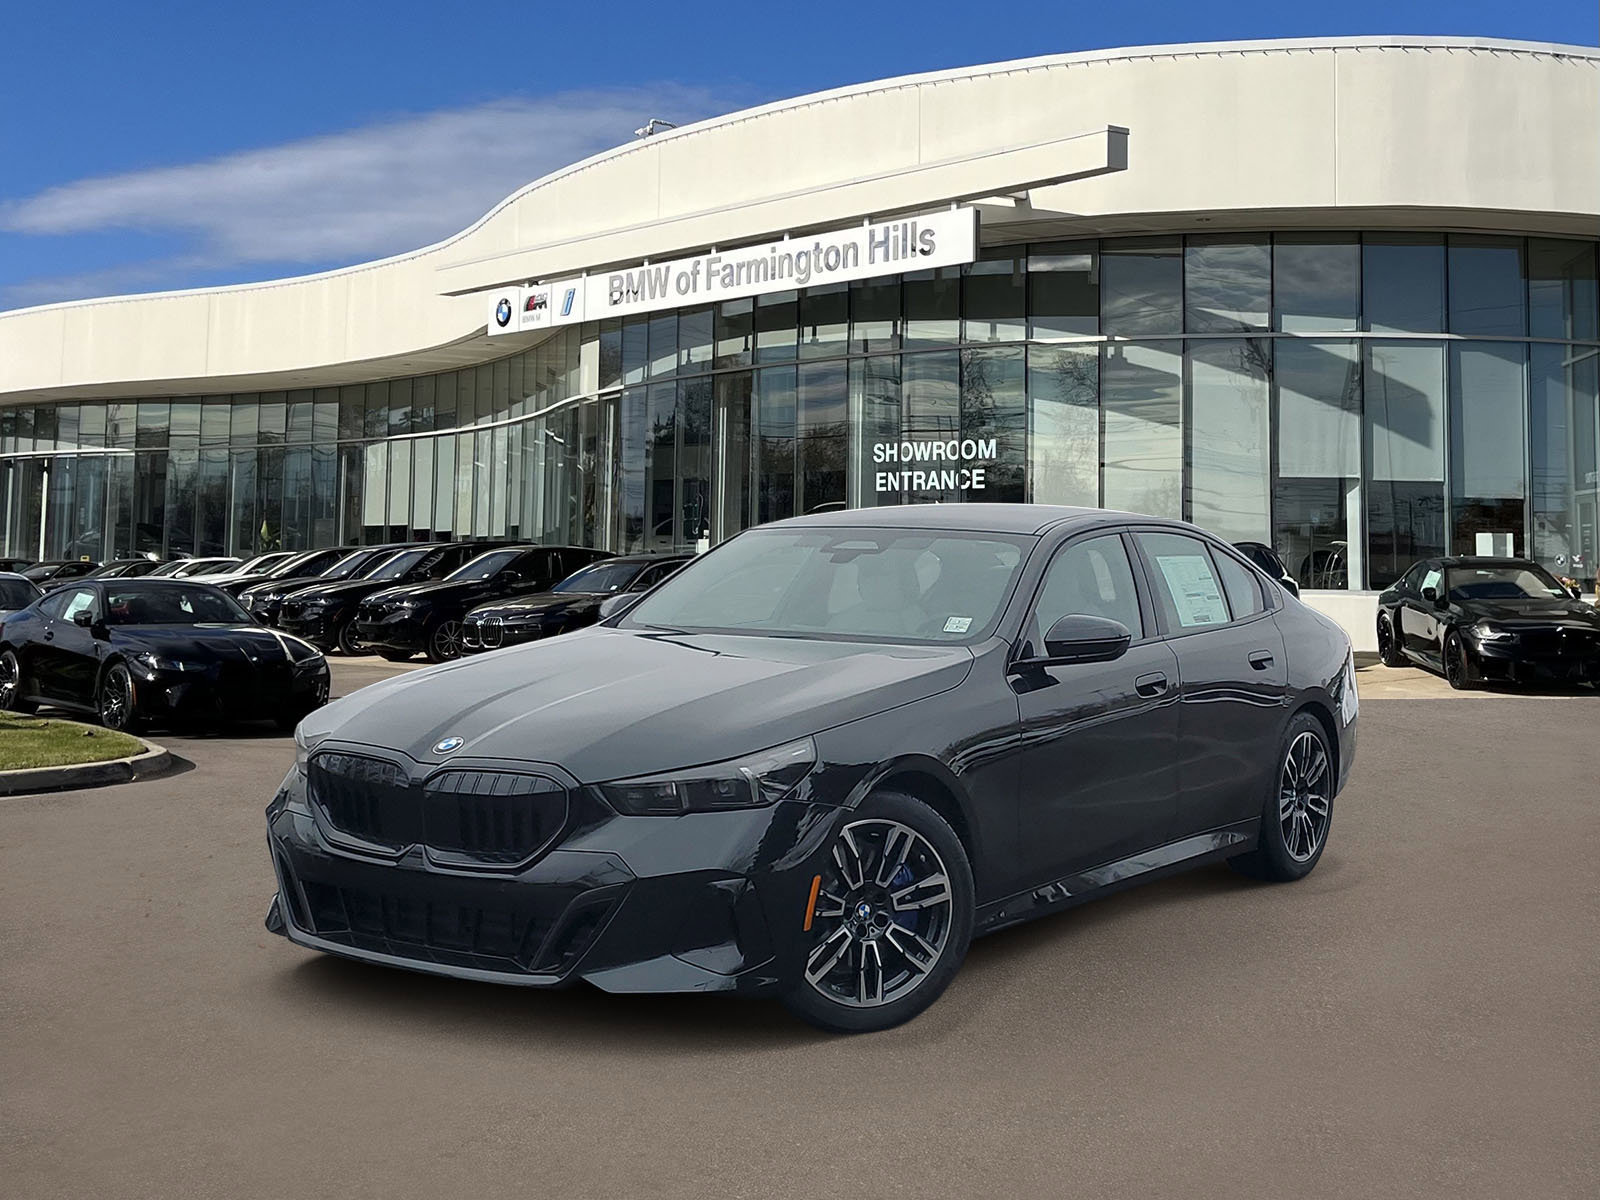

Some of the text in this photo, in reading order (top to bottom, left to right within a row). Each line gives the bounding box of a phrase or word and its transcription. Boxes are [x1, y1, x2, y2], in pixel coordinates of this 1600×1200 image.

[608, 220, 936, 306] BMW of Farmington Hills
[872, 438, 997, 463] SHOWROOM
[875, 468, 986, 492] ENTRANCE
